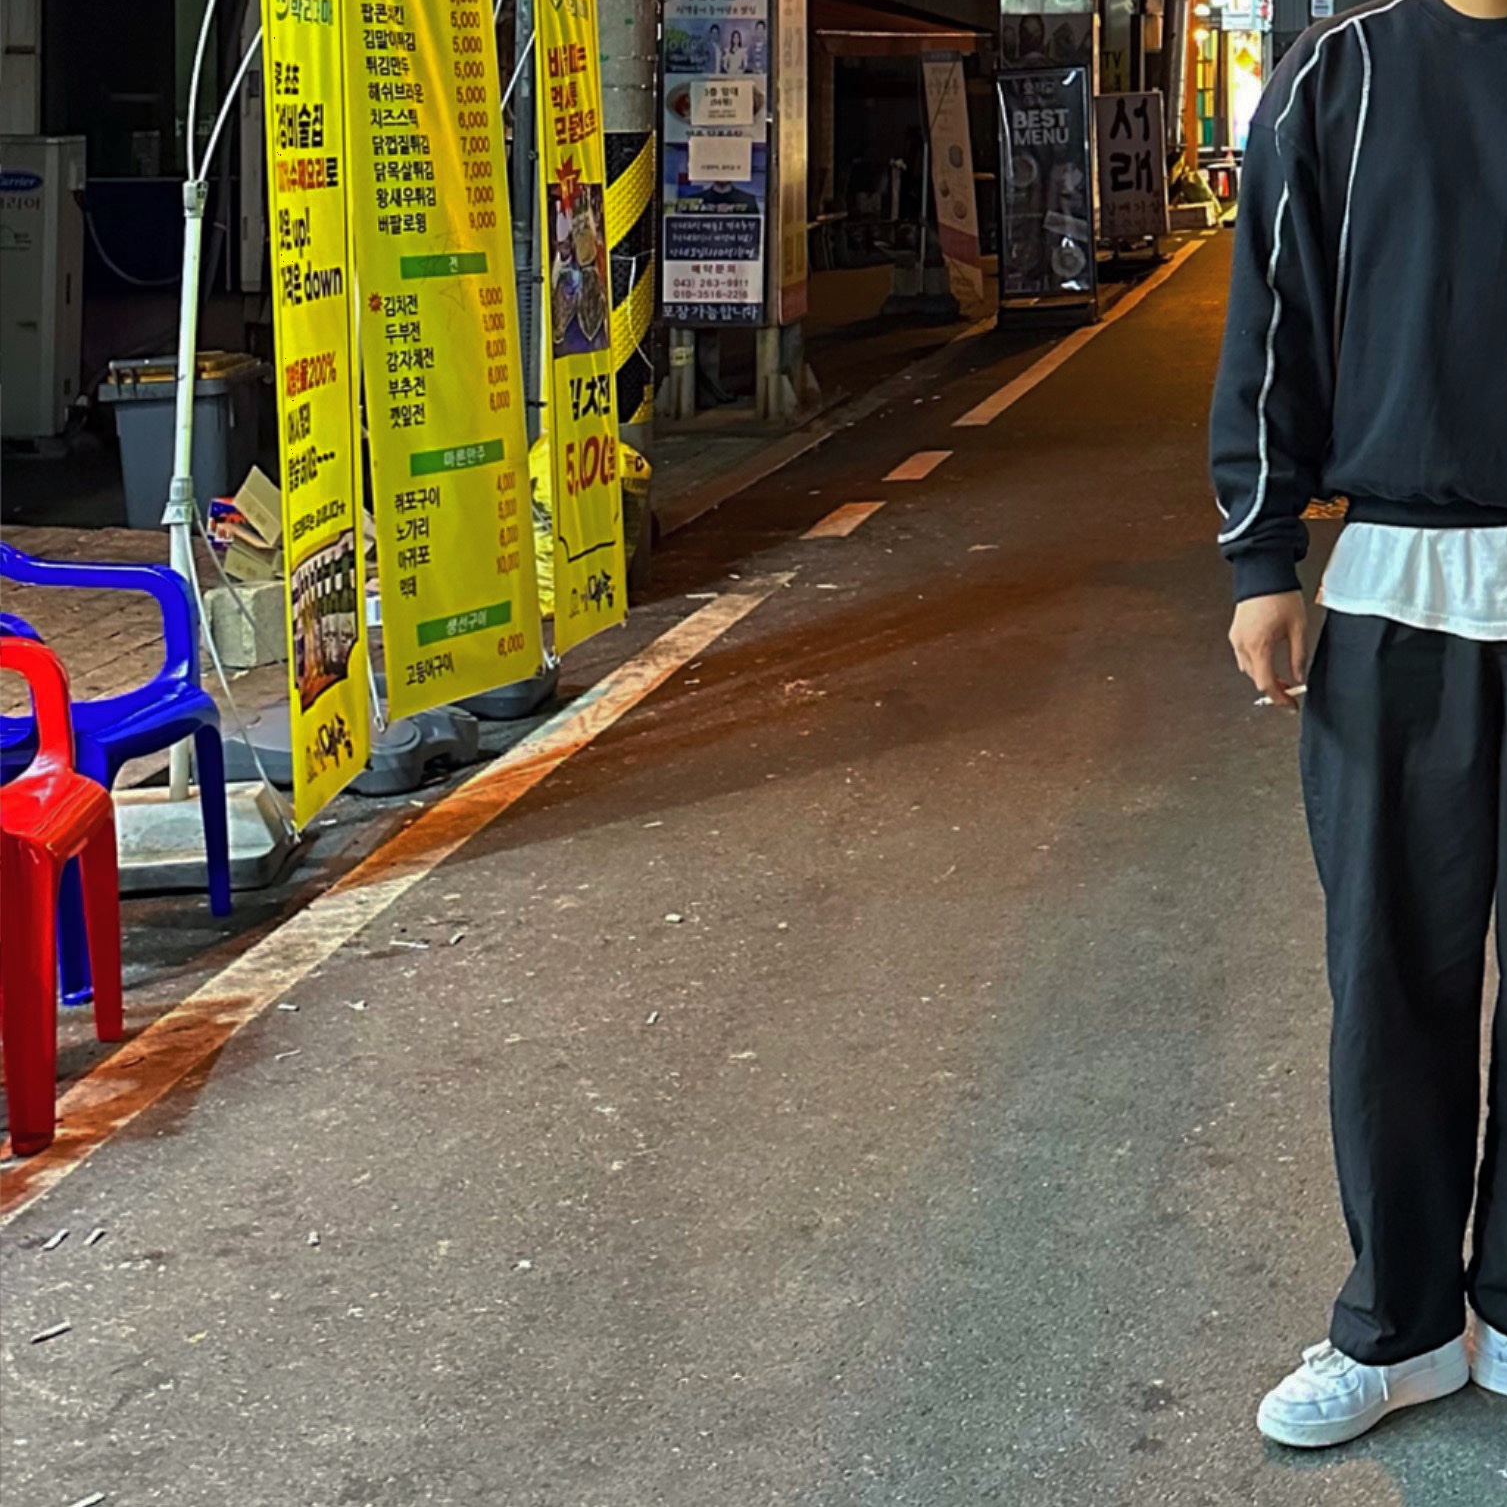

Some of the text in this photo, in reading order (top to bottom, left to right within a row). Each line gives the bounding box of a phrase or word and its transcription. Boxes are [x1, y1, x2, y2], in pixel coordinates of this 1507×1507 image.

[450, 11, 480, 30] 5,000
[452, 36, 483, 55] 5,000
[454, 61, 484, 81] 5,000
[456, 86, 486, 105] 5,000
[458, 111, 488, 130] 6,000
[1013, 108, 1069, 129] BEST
[460, 136, 490, 156] 7,000
[1013, 128, 1069, 146] MENU
[463, 161, 492, 181] 7,000
[466, 186, 494, 206] 7,000
[396, 516, 430, 542] 노가리
